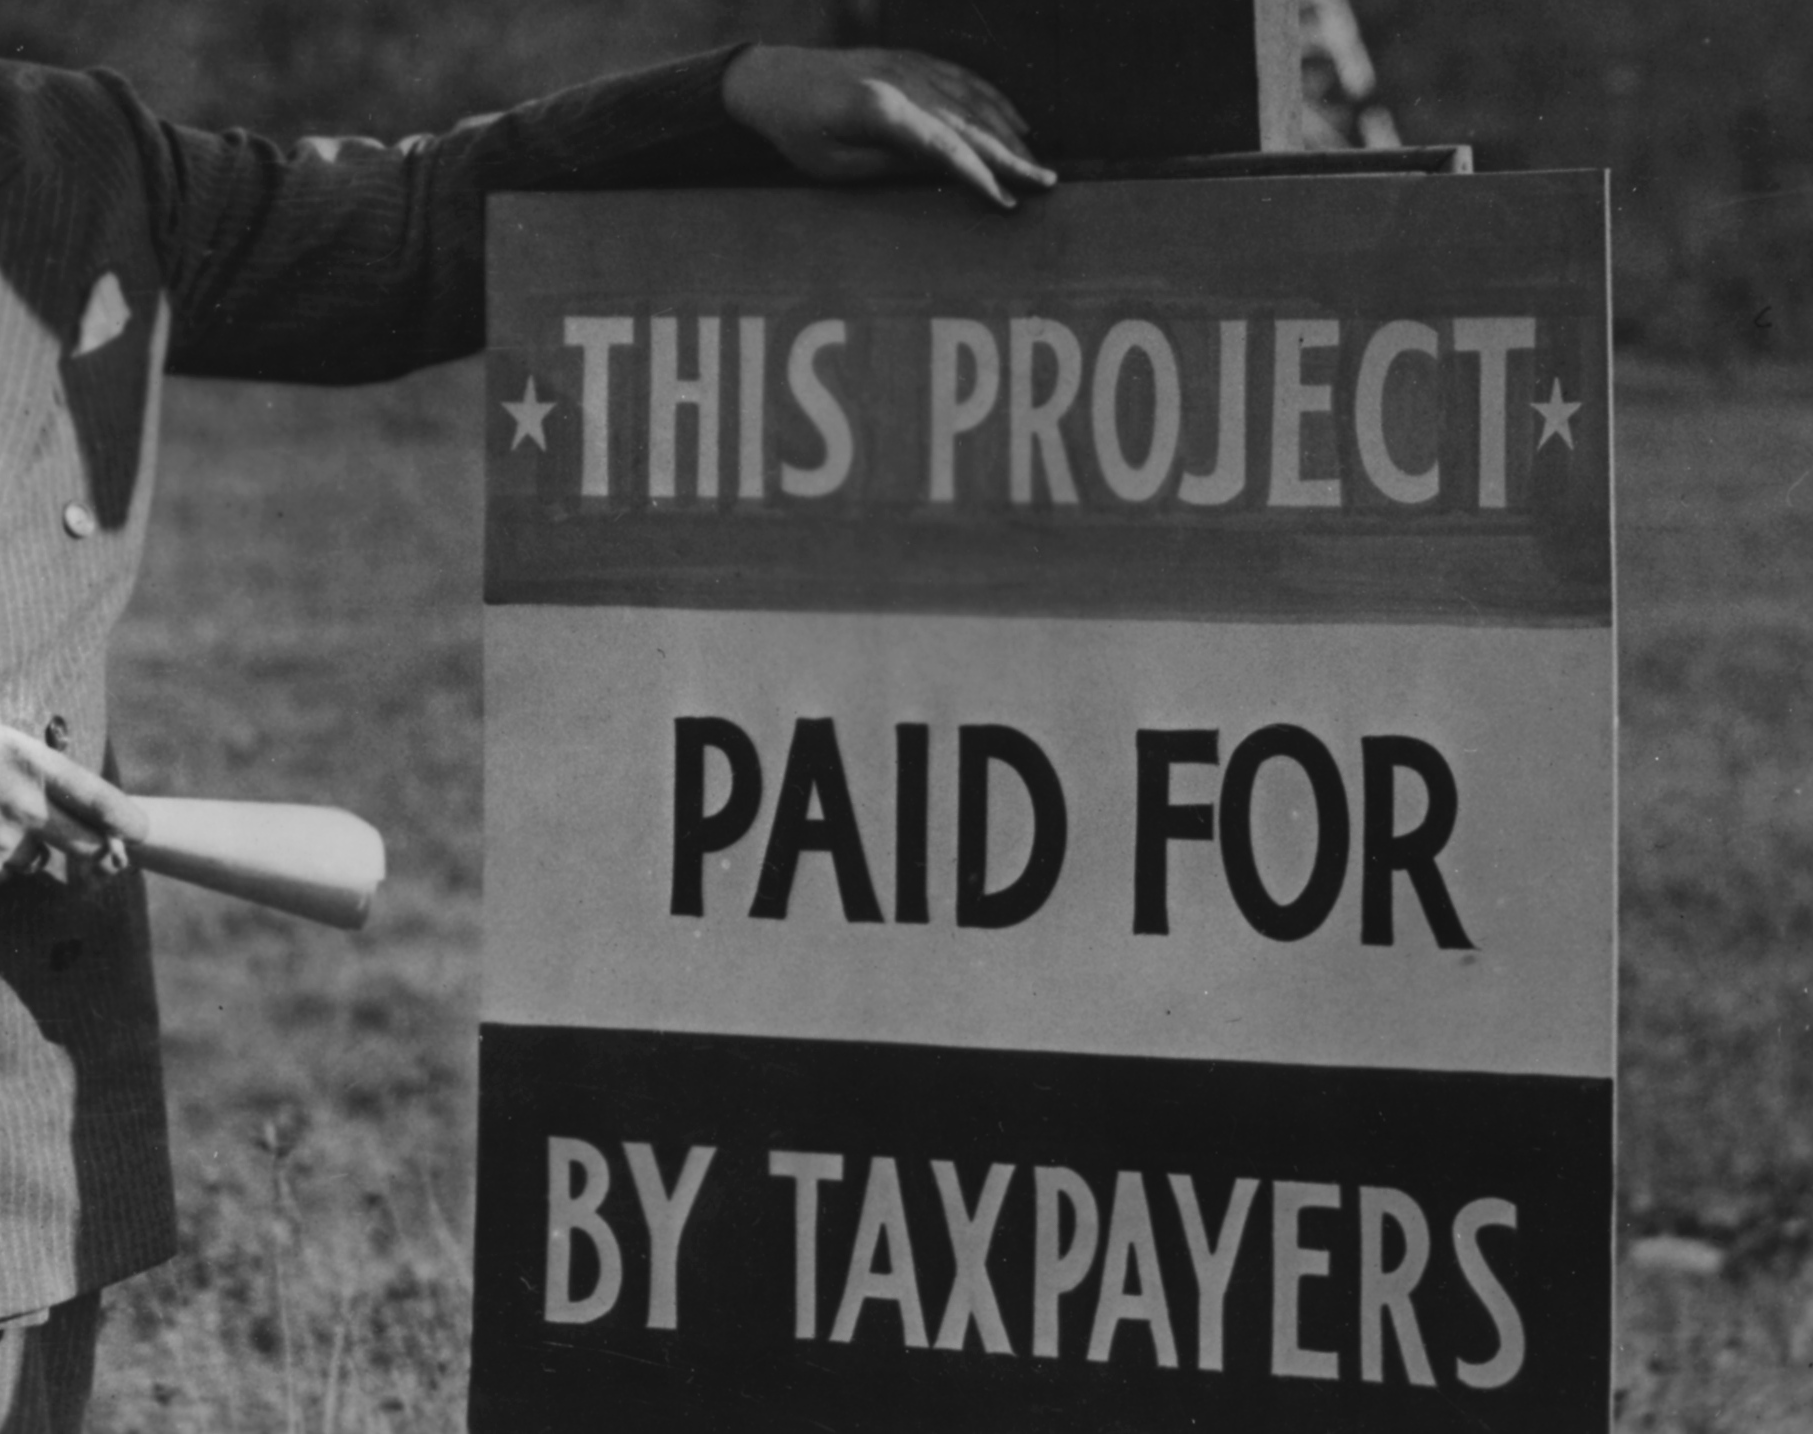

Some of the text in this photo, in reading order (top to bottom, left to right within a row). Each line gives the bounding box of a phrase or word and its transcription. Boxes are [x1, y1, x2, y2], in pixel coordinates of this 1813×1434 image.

[563, 316, 1536, 509] THIS PROJECT
[669, 716, 1478, 950] PAID FOR
[543, 1135, 1526, 1390] BY TAXPAYERS
